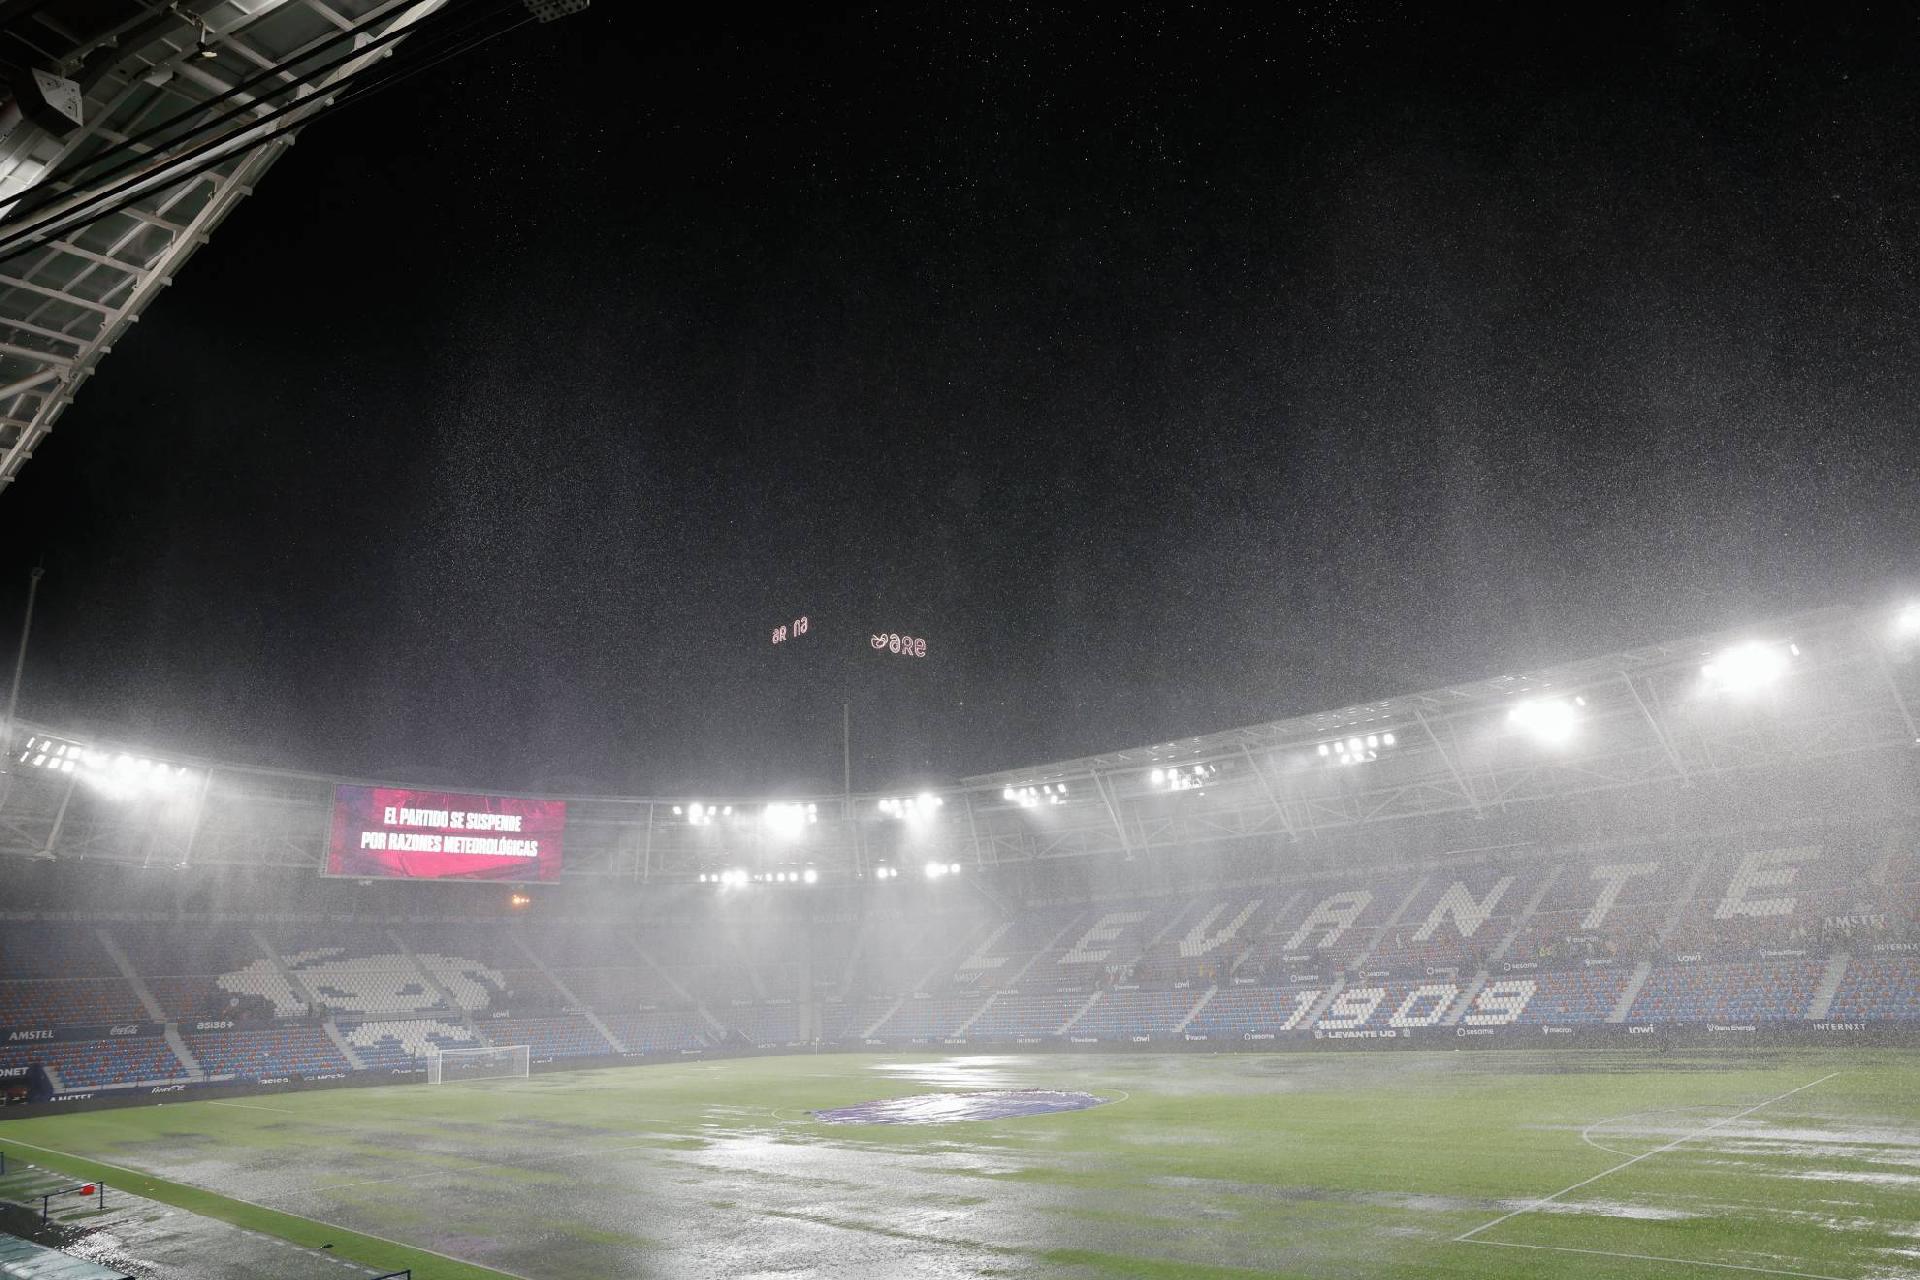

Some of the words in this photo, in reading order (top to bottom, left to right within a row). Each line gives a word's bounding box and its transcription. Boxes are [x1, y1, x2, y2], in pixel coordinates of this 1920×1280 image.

[384, 807, 397, 825] EL
[399, 808, 449, 828] PARTIDO
[450, 812, 465, 829] SE
[466, 813, 522, 832] SUSPENDE
[360, 831, 387, 850] POR
[388, 832, 442, 853] RAZONES
[443, 836, 538, 857] METEOROLÓGICAS
[1280, 979, 1537, 1031] 1909
[9, 1030, 55, 1041] AMSTEL
[1328, 1030, 1377, 1039] LEVANTE
[1379, 1030, 1396, 1038] UD
[1813, 1023, 1866, 1032] INTERNXT
